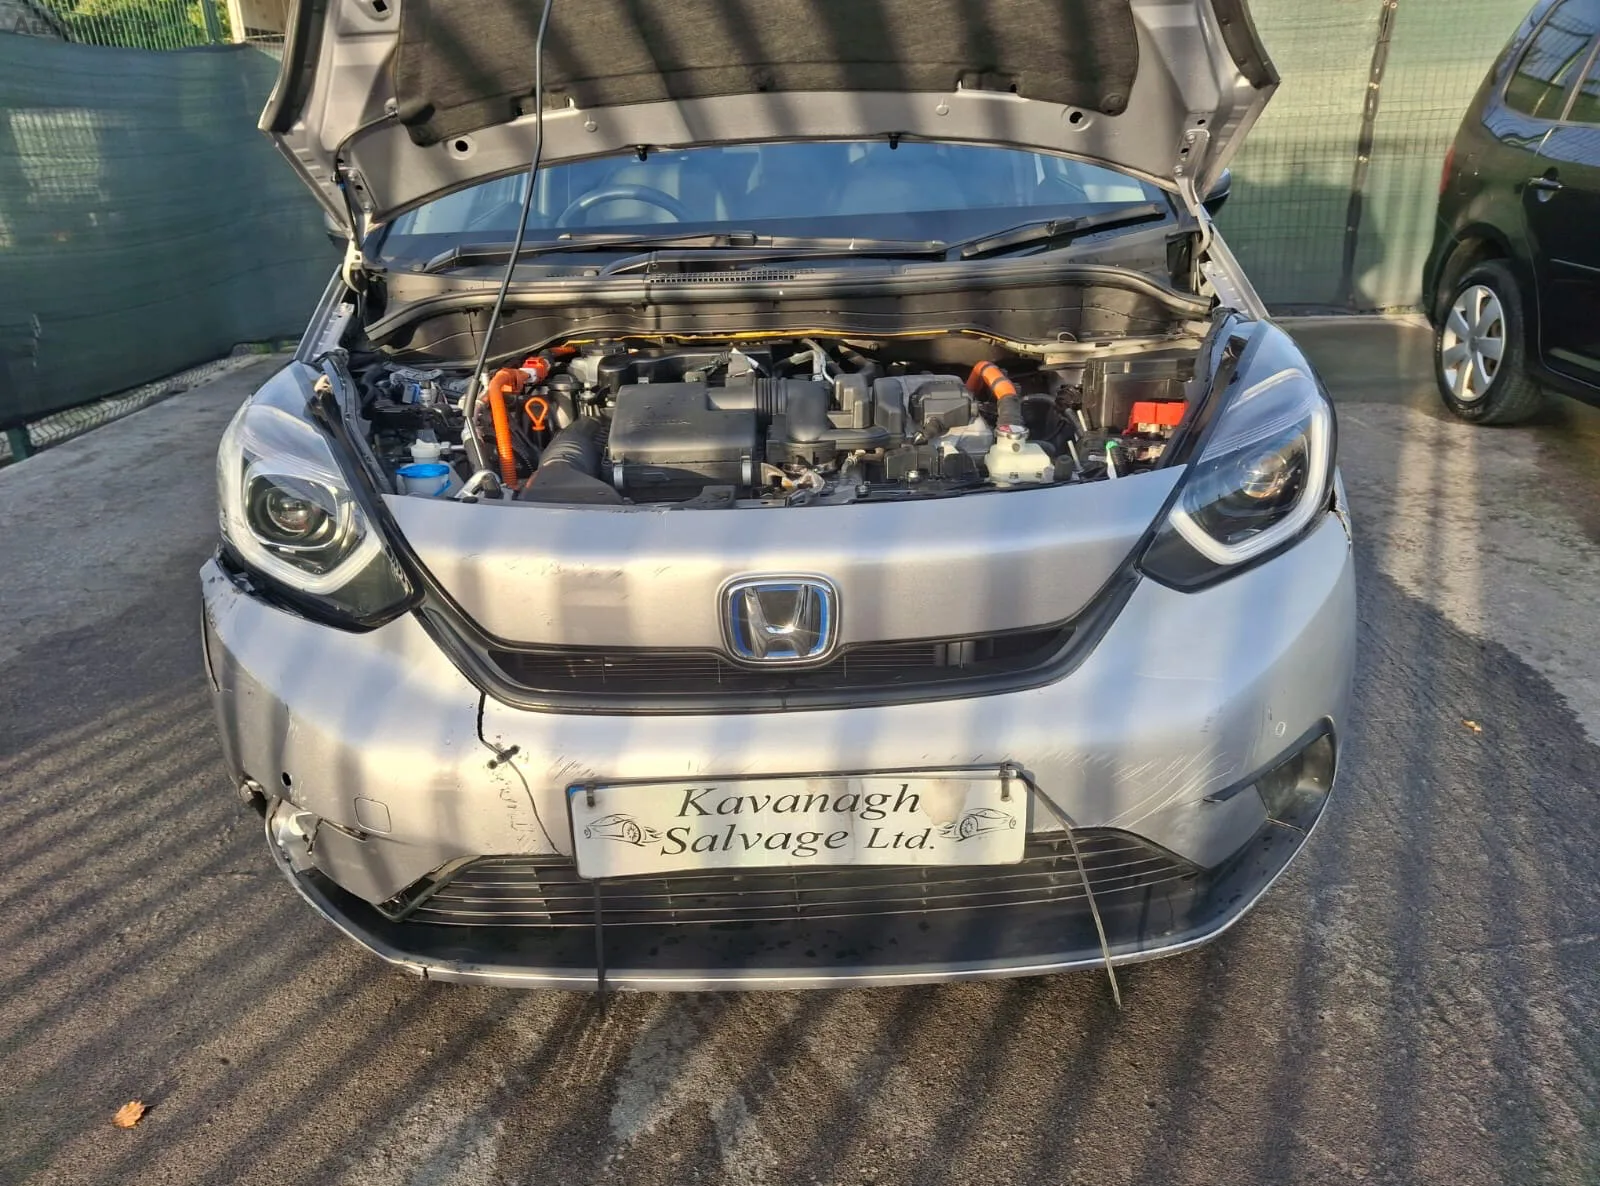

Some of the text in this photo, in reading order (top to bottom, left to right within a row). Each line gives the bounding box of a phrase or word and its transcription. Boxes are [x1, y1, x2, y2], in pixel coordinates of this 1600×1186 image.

[678, 783, 920, 821] Kavanagh
[660, 824, 936, 858] Salvage Ltd.
